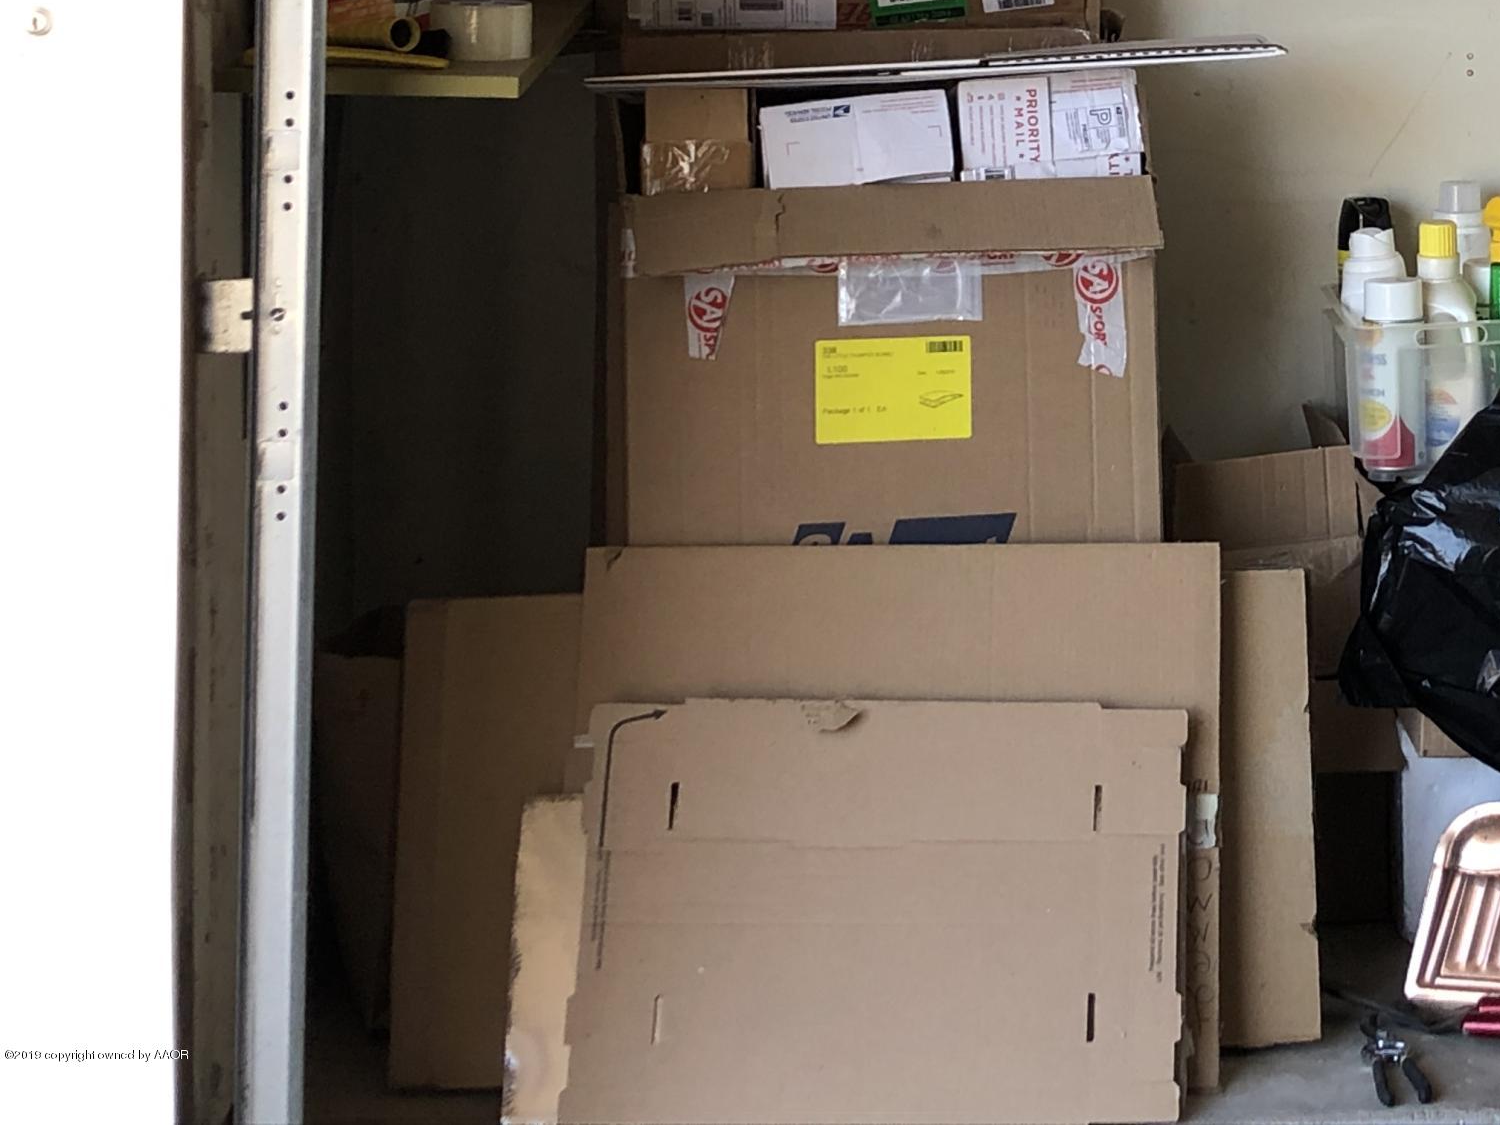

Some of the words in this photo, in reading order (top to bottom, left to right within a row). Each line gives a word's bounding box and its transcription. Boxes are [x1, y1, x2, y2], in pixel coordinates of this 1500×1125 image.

[1014, 107, 1025, 146] MAIL
[1026, 89, 1040, 163] PRIORITY
[1089, 108, 1112, 125] P
